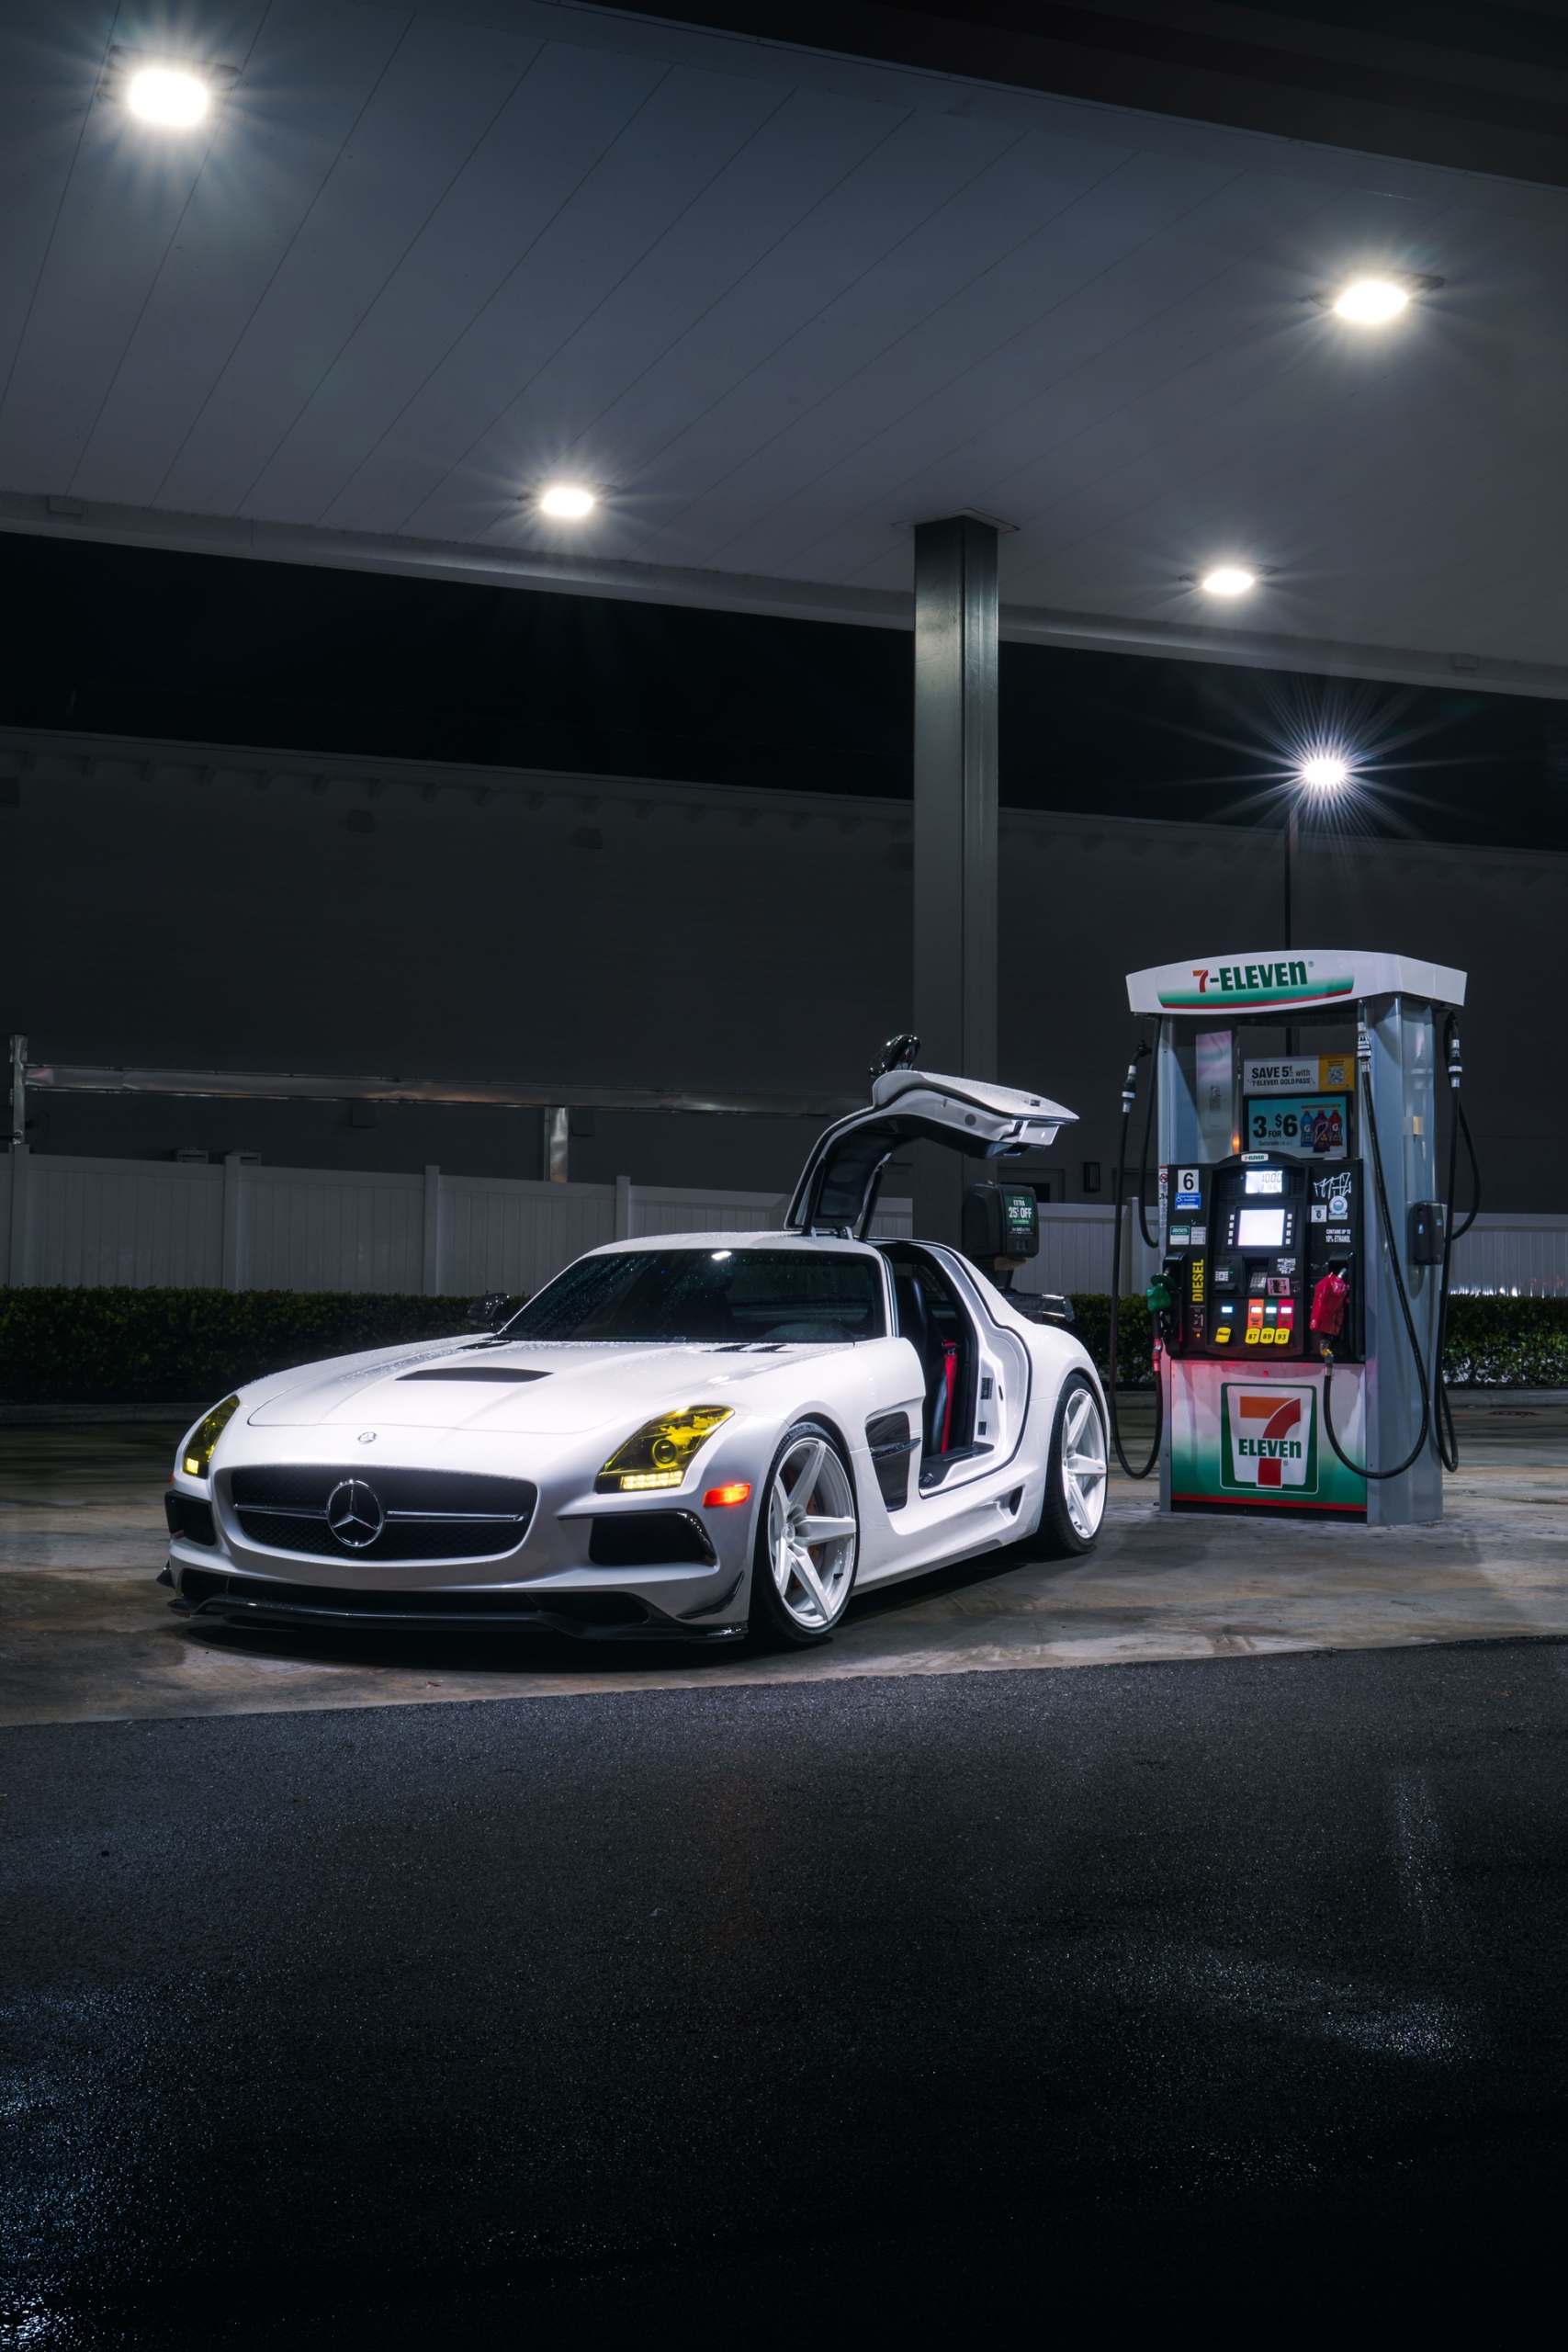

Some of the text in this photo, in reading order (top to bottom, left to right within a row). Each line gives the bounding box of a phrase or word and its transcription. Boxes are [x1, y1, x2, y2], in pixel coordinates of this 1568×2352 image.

[1252, 1067, 1280, 1079] SAVE
[1295, 1069, 1311, 1077] with
[1253, 1115, 1267, 1138] 3
[1183, 1172, 1194, 1191] 6
[1021, 1207, 1032, 1218] OFF
[1325, 1235, 1351, 1243] 10% ETHANOL
[1191, 1259, 1204, 1302] DIESEL
[1239, 1395, 1302, 1487] 7
